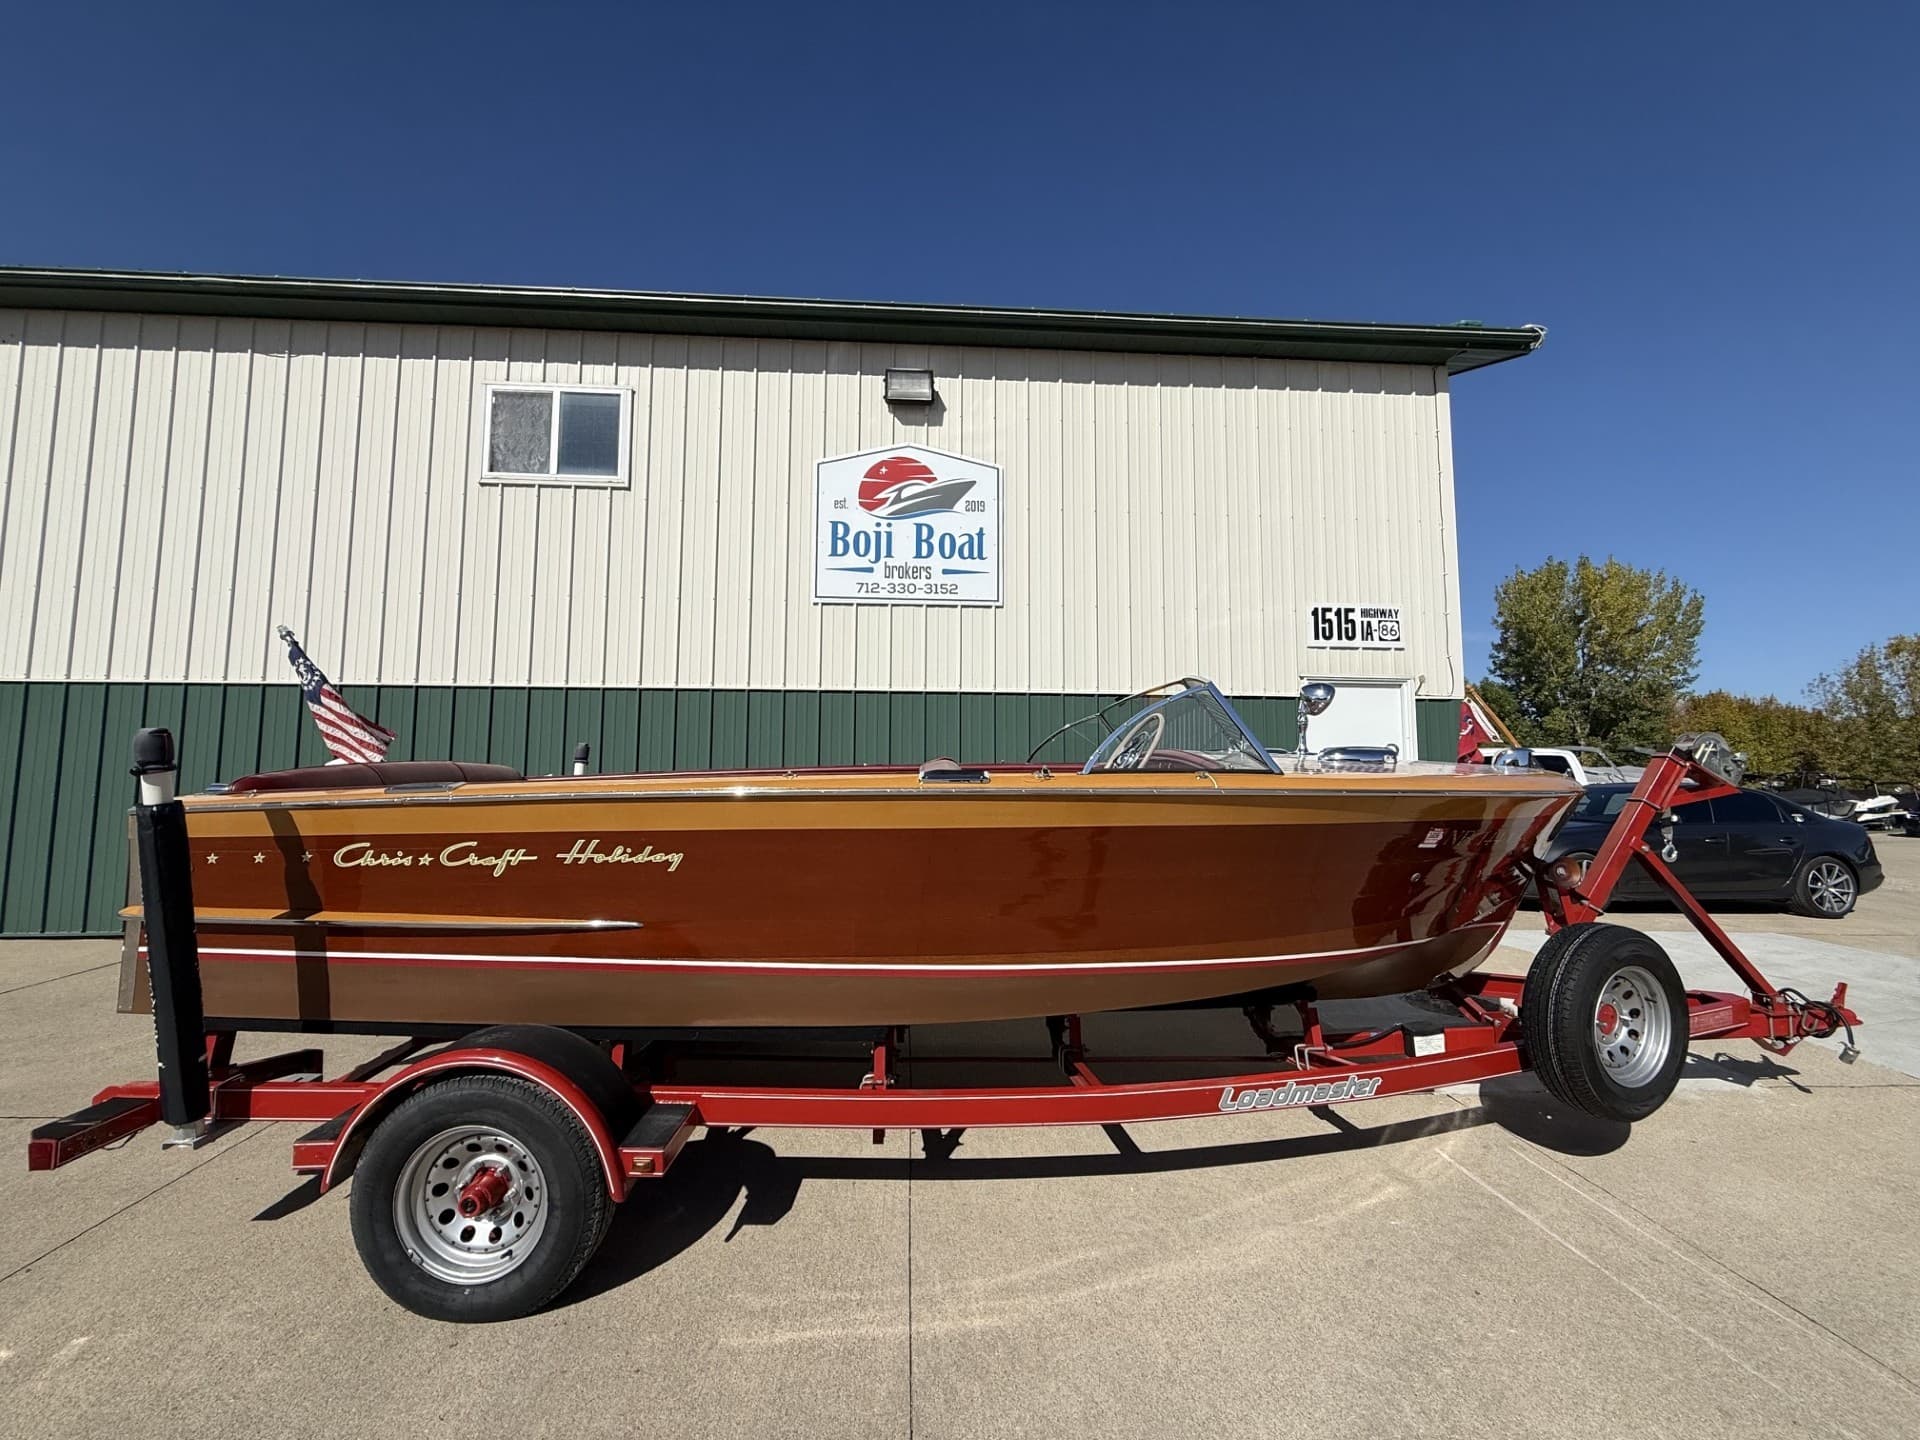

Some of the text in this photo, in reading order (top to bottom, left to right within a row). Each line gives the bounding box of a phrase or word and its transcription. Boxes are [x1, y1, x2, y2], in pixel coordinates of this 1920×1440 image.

[833, 497, 986, 513] est. 2019
[828, 520, 988, 564] Boji Boat
[883, 561, 932, 580] brokers
[856, 582, 959, 595] 712-330-3152
[1311, 607, 1357, 641] 1515
[1360, 607, 1400, 619] HIGHWAY
[333, 839, 684, 877] Chris Craft Holiday
[1218, 1074, 1384, 1112] Loadmaster
